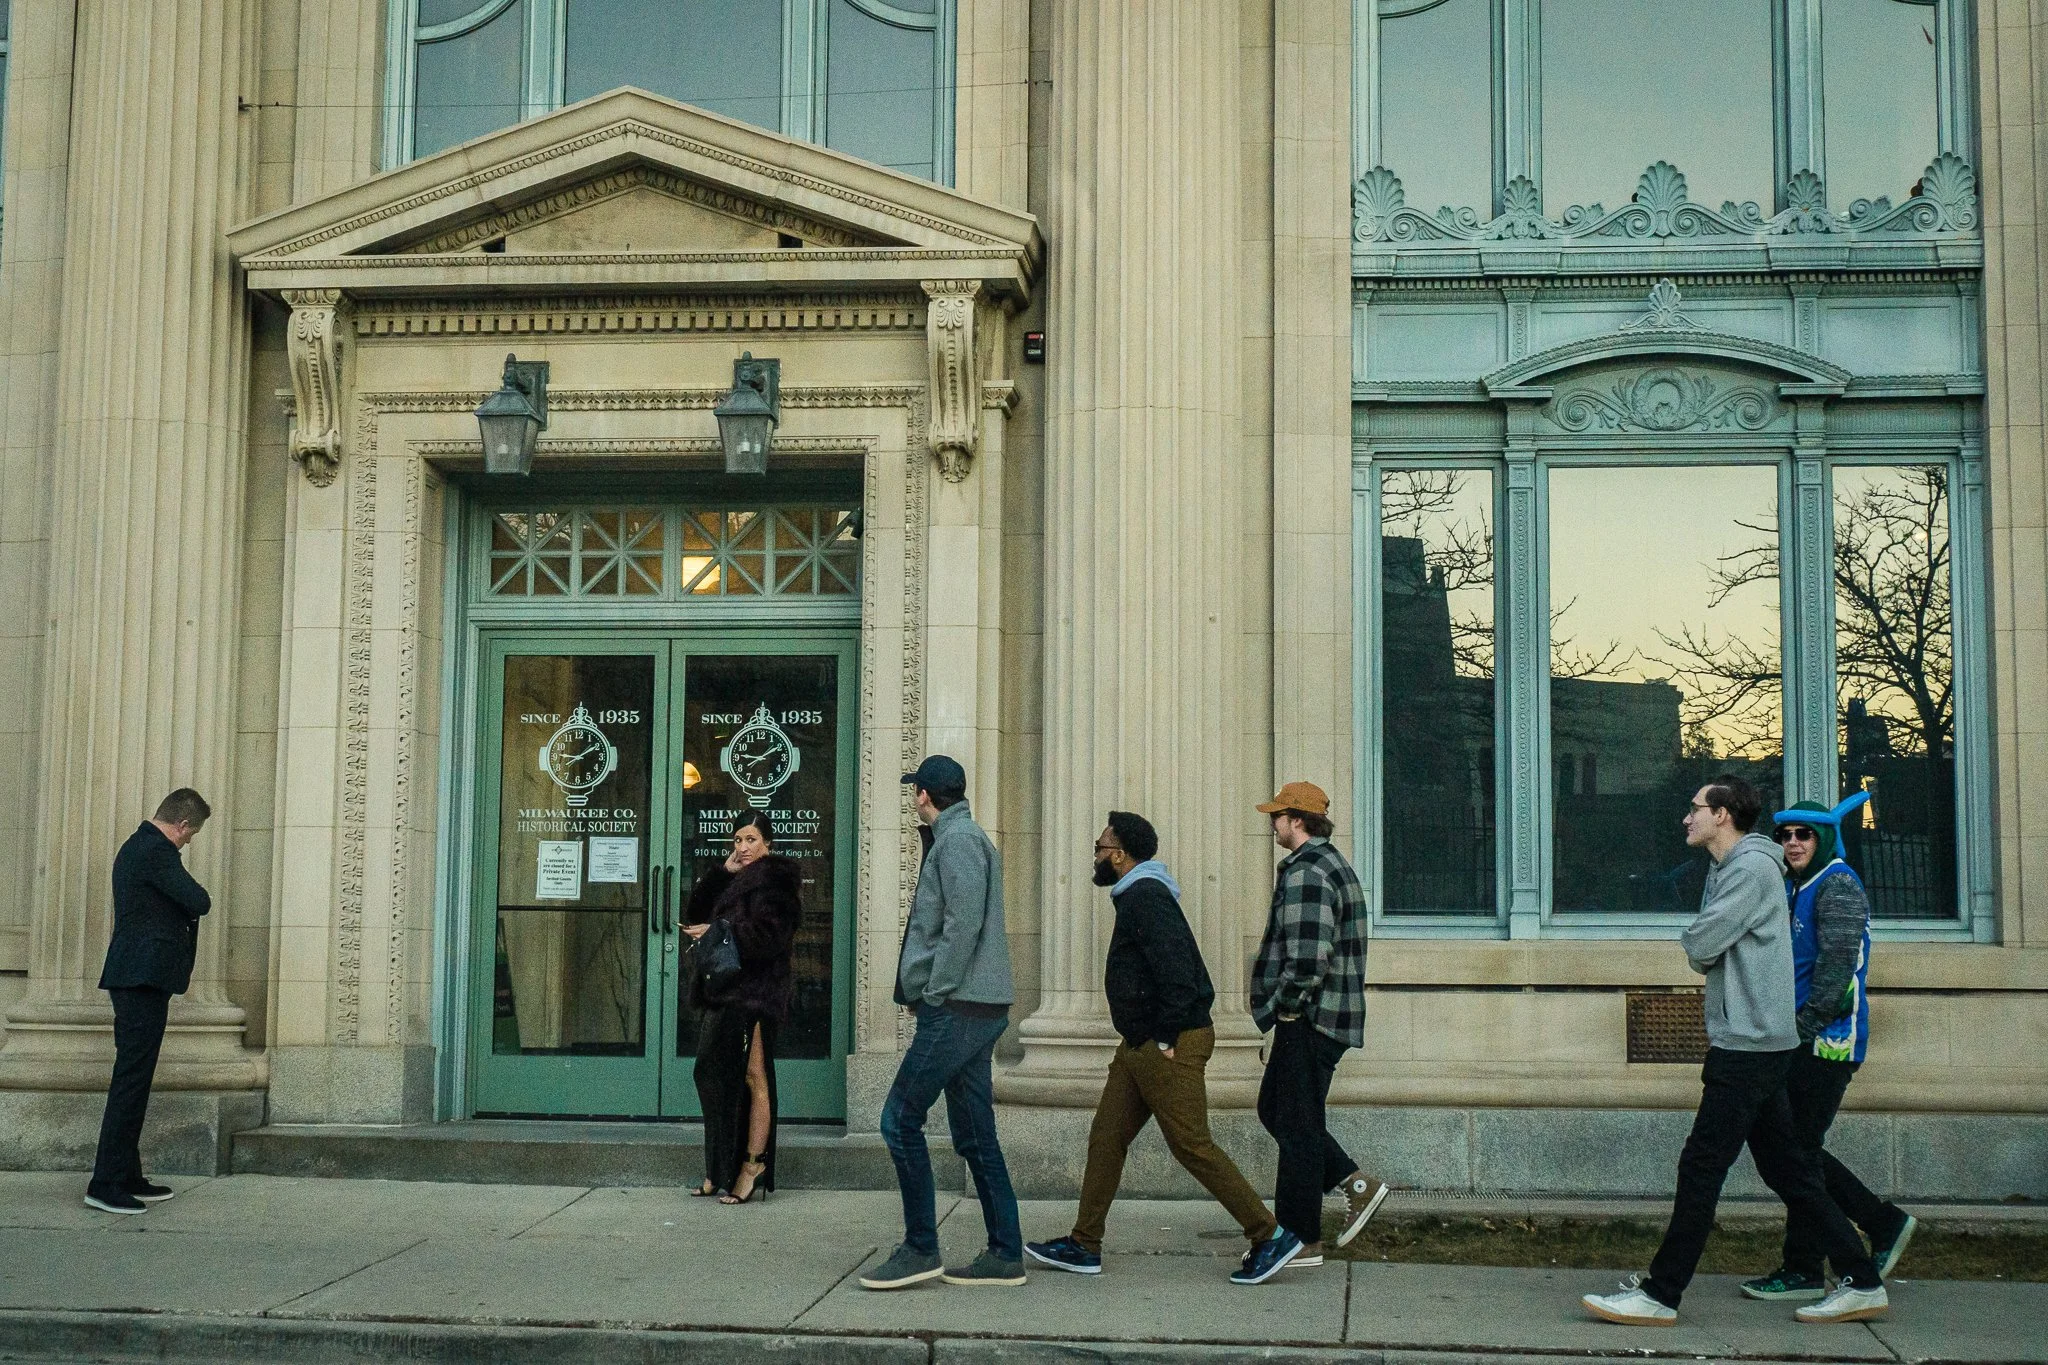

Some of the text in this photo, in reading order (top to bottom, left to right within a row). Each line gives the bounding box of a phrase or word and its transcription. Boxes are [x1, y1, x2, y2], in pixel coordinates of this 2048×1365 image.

[520, 710, 640, 724] SINCE 1935
[701, 710, 823, 725] SINCE 1935
[564, 734, 573, 742] 11
[575, 731, 584, 739] 12
[588, 734, 592, 742] 1
[746, 734, 755, 743] 11
[756, 731, 766, 740] 12
[769, 734, 774, 743] 1
[556, 743, 566, 751] 10
[594, 743, 600, 751] 2
[738, 743, 748, 752] 10
[777, 743, 783, 752] 2
[552, 753, 558, 761] 9
[598, 753, 604, 761] 3
[734, 753, 740, 762] 9
[780, 753, 787, 762] 3
[555, 763, 561, 771] 8
[593, 763, 599, 772] 4
[737, 764, 743, 772] 8
[775, 764, 781, 773] 4
[564, 772, 570, 780] 7
[575, 775, 581, 784] 6
[585, 772, 592, 781] 5
[745, 773, 752, 781] 7
[757, 776, 763, 785] 6
[768, 773, 774, 782] 5
[518, 808, 638, 819] MILWAUKEE CO.
[699, 809, 821, 820] MILWEE CO.
[517, 821, 637, 833] HISTORICAL SOCIETY
[698, 822, 820, 834] HISTO SOCIETY
[694, 848, 710, 857] 910
[710, 848, 719, 857] N.
[785, 849, 803, 859] King
[803, 849, 812, 858] Jr.
[813, 849, 825, 858] Dr.
